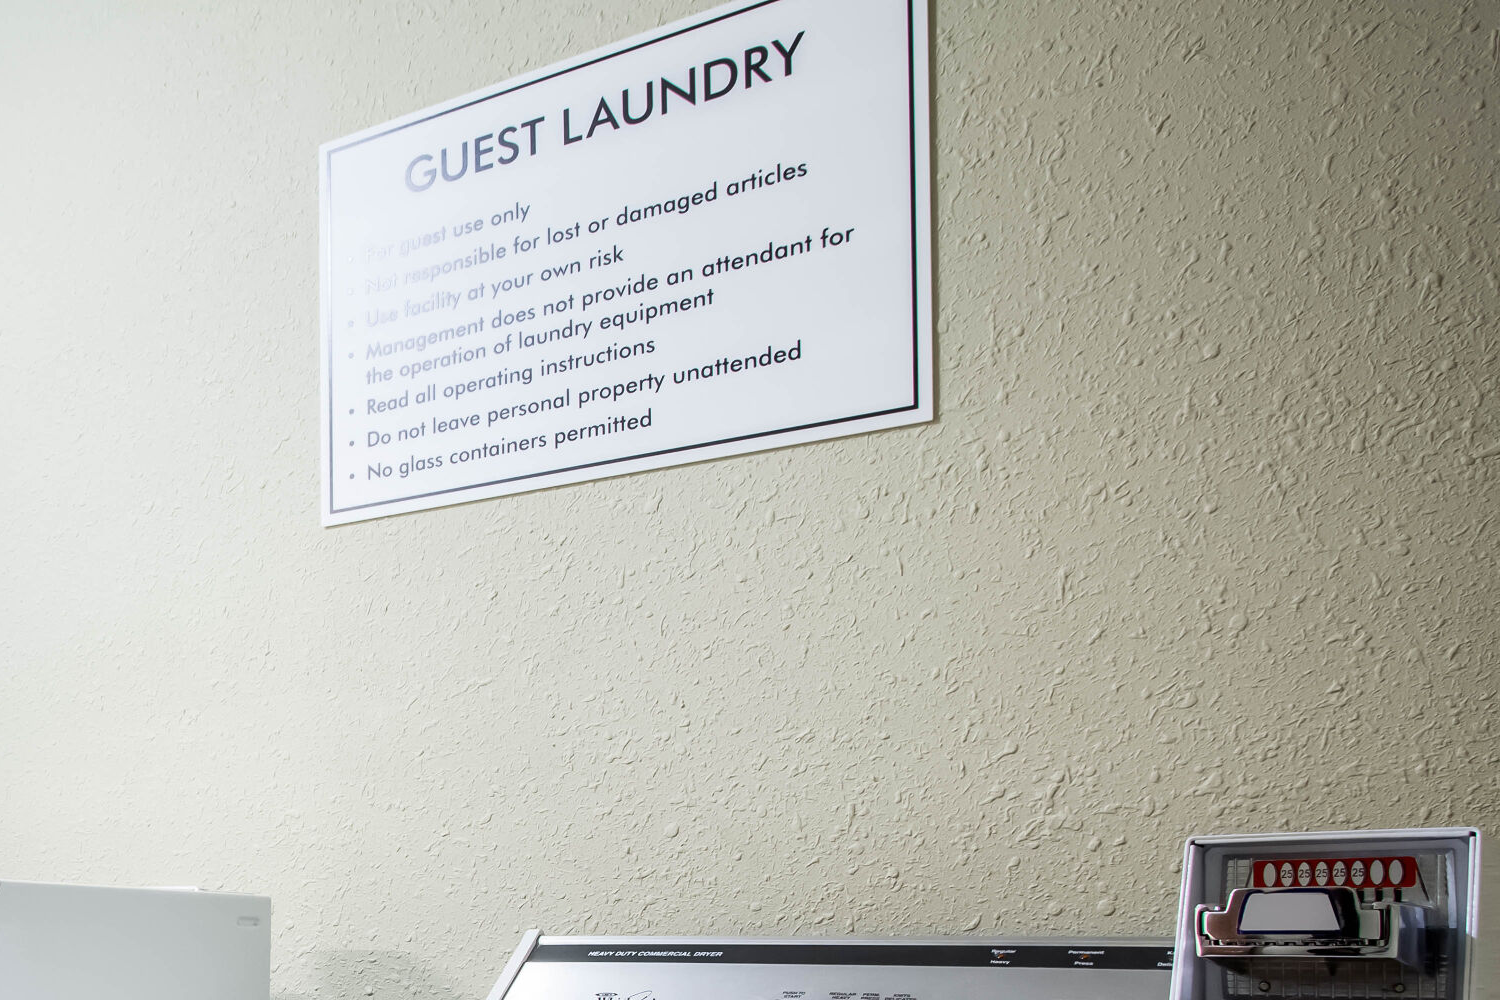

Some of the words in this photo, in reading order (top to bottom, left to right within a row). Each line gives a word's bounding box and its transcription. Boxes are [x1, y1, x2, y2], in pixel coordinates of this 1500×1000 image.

[404, 116, 545, 193] GUEST
[563, 30, 806, 146] LAUNDRY
[399, 226, 447, 256] guest
[453, 218, 484, 238] use
[491, 202, 530, 226] only
[405, 243, 507, 283] responsible
[513, 235, 540, 255] for
[547, 222, 581, 246] lost
[588, 217, 609, 234] or
[616, 181, 718, 226] damaged
[726, 162, 808, 197] articles
[365, 317, 485, 361] Management
[491, 307, 536, 330] does
[543, 294, 574, 316] not
[582, 274, 658, 311] provide
[666, 268, 694, 286] an
[702, 235, 813, 277] attendant
[820, 227, 855, 248] for
[404, 290, 462, 318] facility
[467, 282, 485, 302] at
[491, 272, 534, 299] your
[540, 260, 581, 282] own
[589, 245, 625, 270] risk
[366, 367, 393, 385] the
[399, 342, 486, 379] operation
[493, 334, 513, 355] of
[519, 319, 593, 349] laundry
[600, 289, 714, 330] equipment
[367, 391, 409, 415] Read
[415, 384, 437, 405] all
[443, 367, 533, 402] operating
[541, 340, 655, 377] instructions
[367, 431, 391, 448] Do
[398, 422, 426, 442] not
[433, 417, 480, 434] leave
[487, 388, 570, 427] personal
[578, 374, 665, 408] property
[673, 339, 801, 385] unattended
[367, 463, 392, 480] No
[399, 455, 443, 478] glass
[449, 433, 547, 465] containers
[554, 408, 652, 449] permitted
[1281, 869, 1293, 879] 25
[1299, 869, 1311, 878] 25
[1316, 868, 1328, 878] 25
[1334, 868, 1346, 877] 25
[1352, 867, 1365, 877] 25
